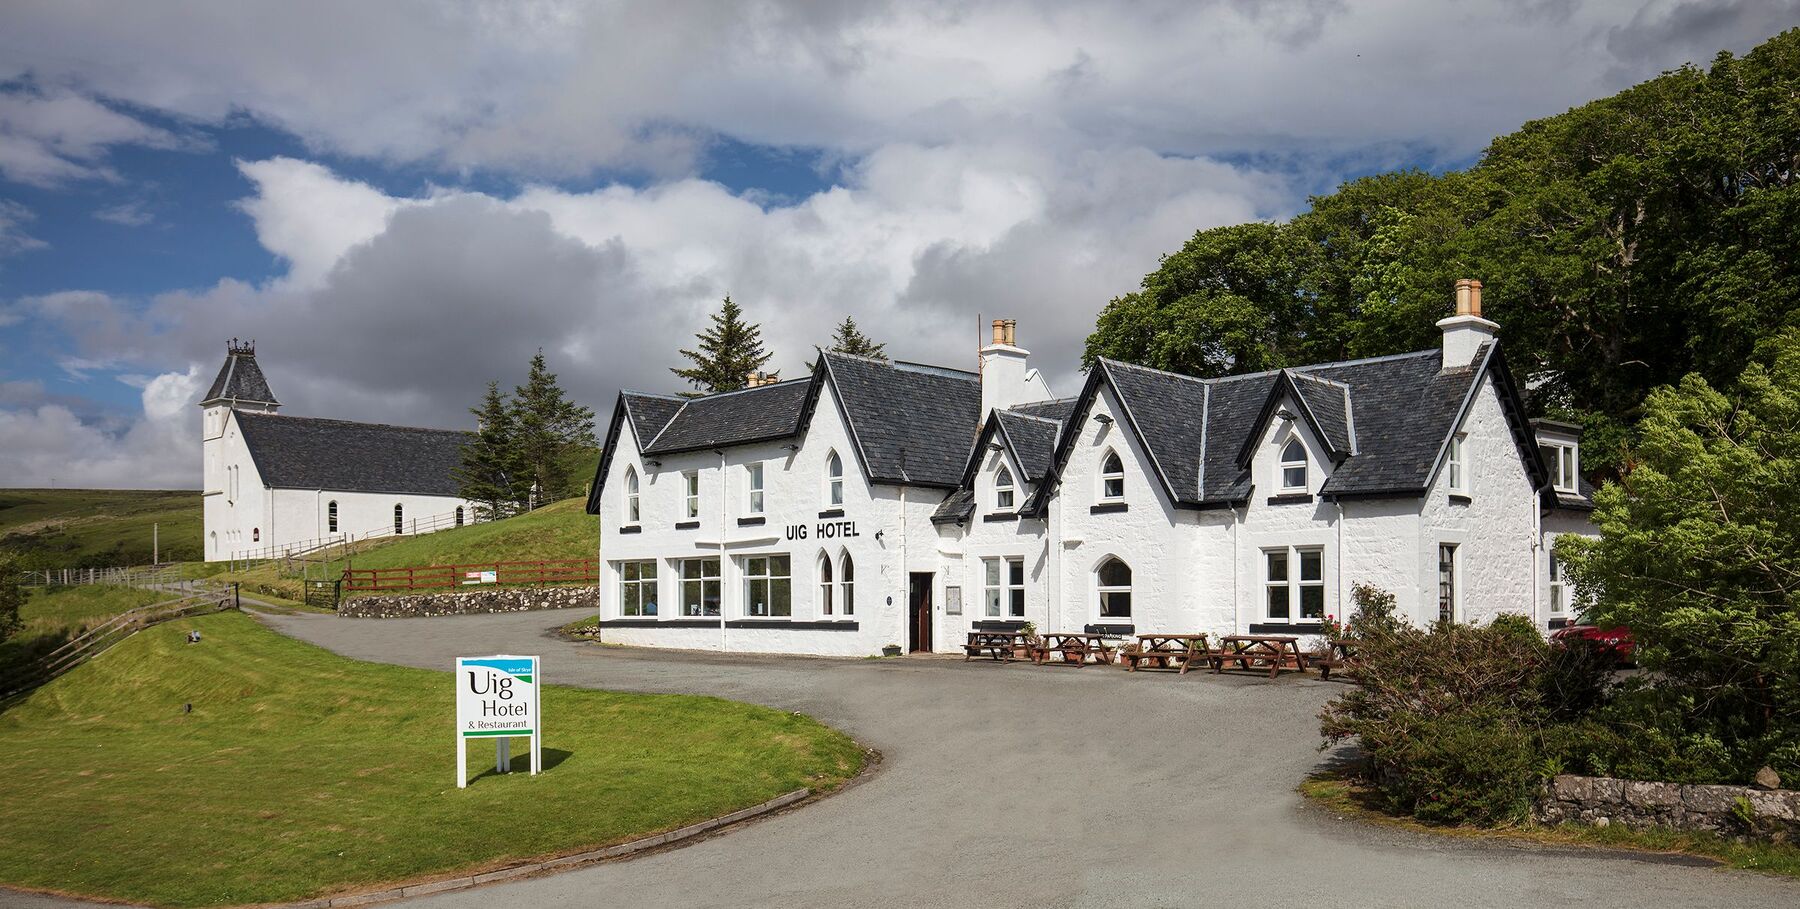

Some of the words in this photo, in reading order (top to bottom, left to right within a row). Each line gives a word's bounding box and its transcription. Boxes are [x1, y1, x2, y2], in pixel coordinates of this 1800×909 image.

[786, 524, 808, 540] UIG
[816, 521, 860, 539] HOTEL
[468, 671, 513, 700] Uig
[482, 700, 527, 716] Hotel
[468, 720, 475, 729] &
[477, 720, 527, 729] Restaurant
